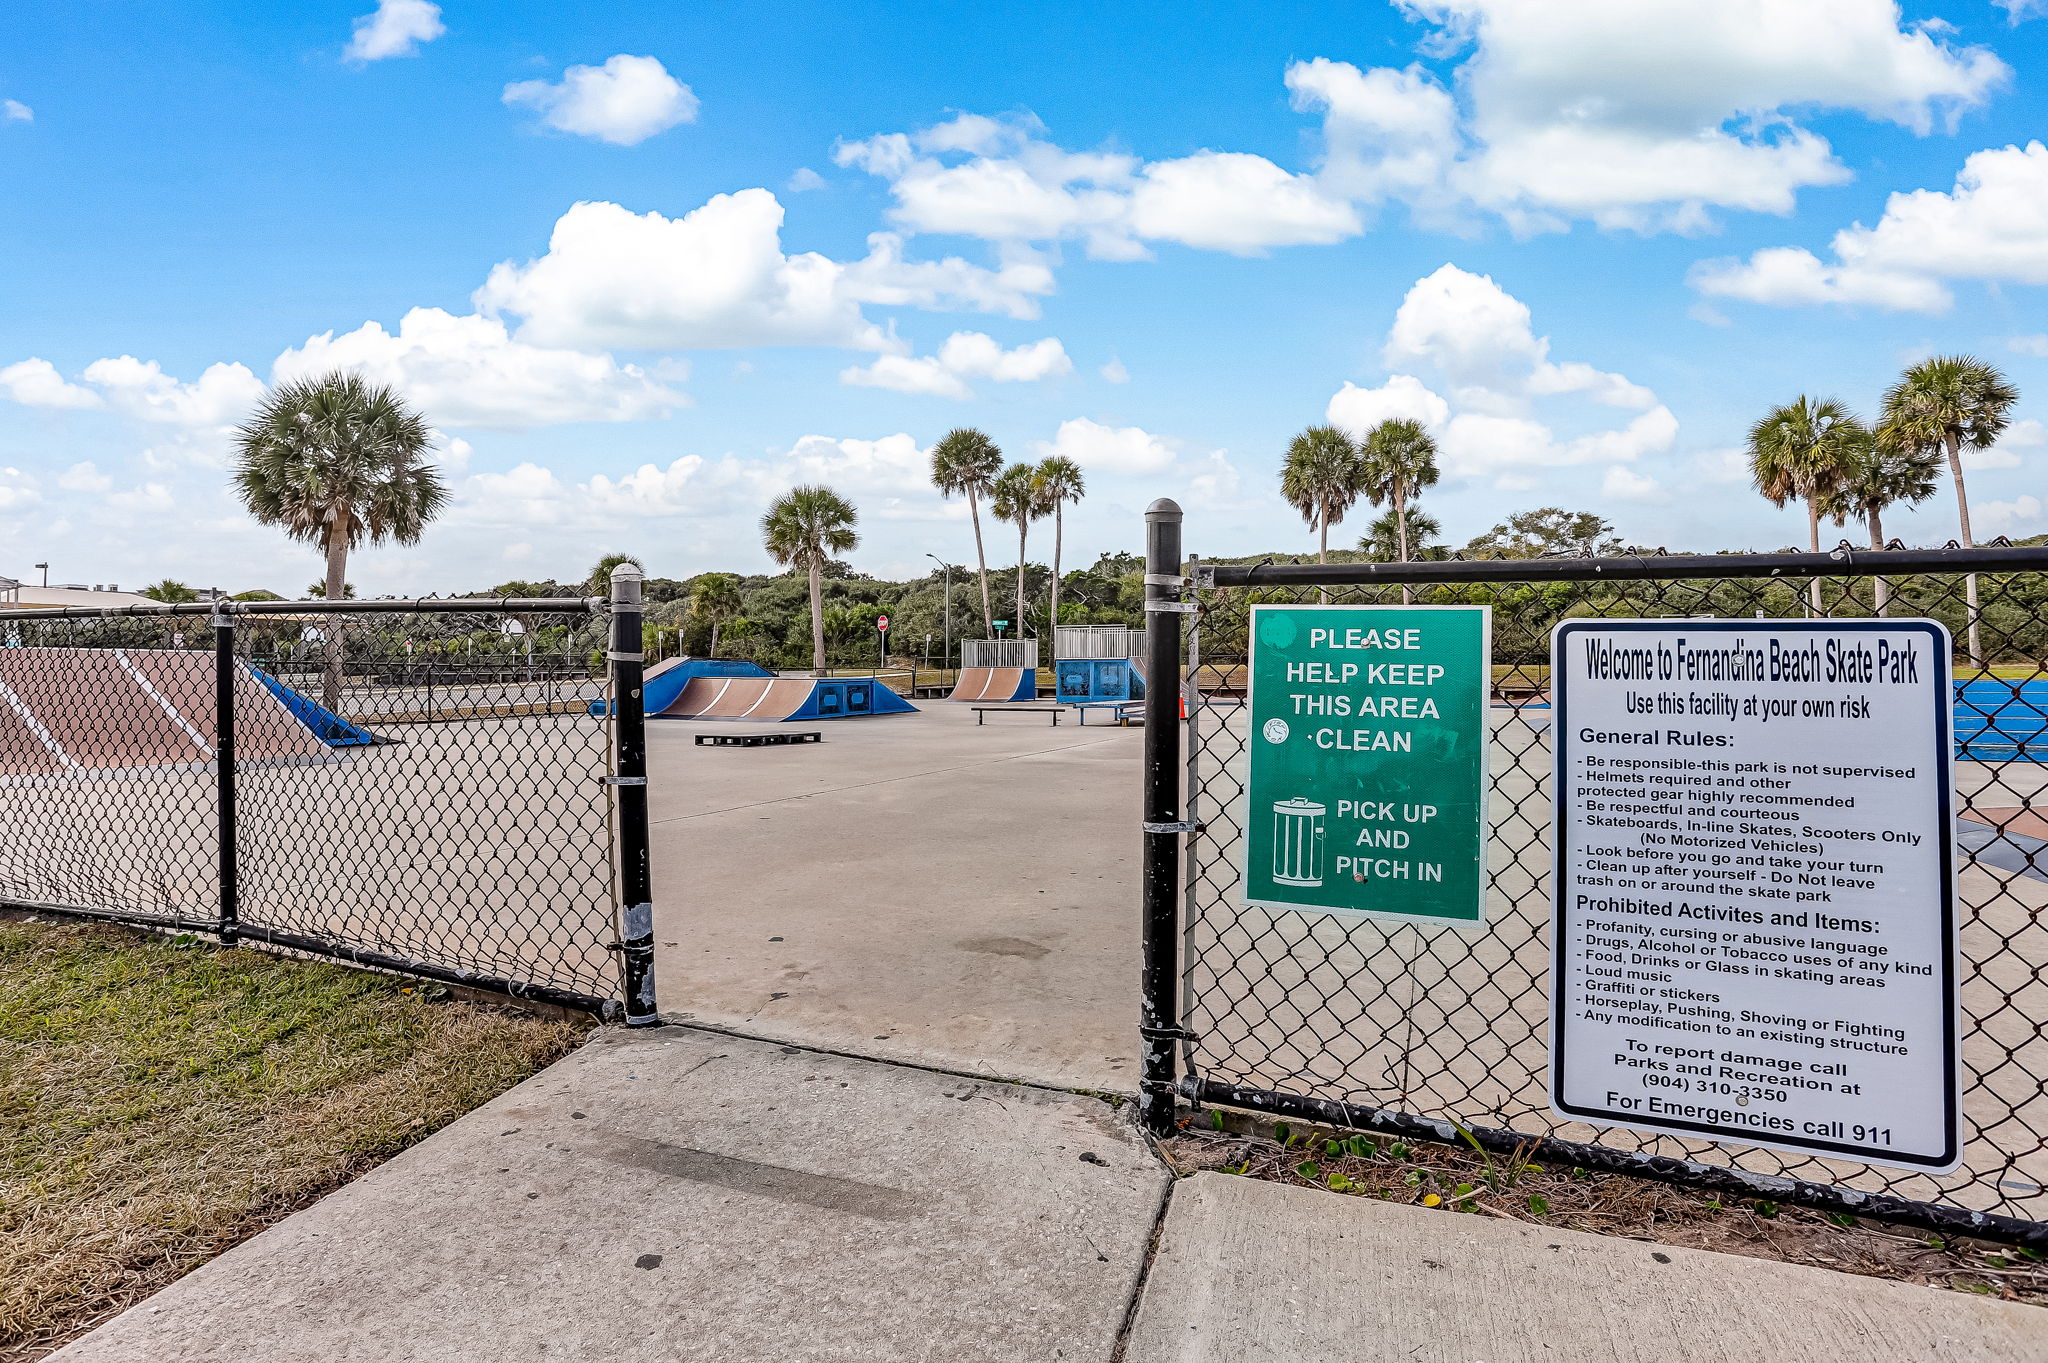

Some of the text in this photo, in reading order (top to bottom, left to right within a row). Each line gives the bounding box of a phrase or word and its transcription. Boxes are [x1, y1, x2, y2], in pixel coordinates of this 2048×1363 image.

[1310, 628, 1421, 650] PLEASE
[1286, 662, 1445, 686] HELP KEEP
[1585, 638, 1918, 684] Welcome to Fernandina Beach Skate Park
[1289, 694, 1441, 719] THIS AREA
[1626, 691, 1870, 723] Use this facility at your own risk
[1315, 727, 1412, 753] CLEAN
[1579, 728, 1734, 747] General Rules:
[1586, 755, 1605, 767] Be
[1610, 758, 1729, 771] responsible-this
[1735, 761, 1768, 774] park
[1774, 762, 1786, 773] is
[1792, 764, 1818, 775] not
[1822, 766, 1915, 779] supervised
[1586, 770, 1644, 783] Helmets
[1649, 774, 1711, 787] required
[1716, 776, 1744, 787] and
[1750, 777, 1791, 789] other
[1337, 799, 1438, 823] PICK UP
[1577, 786, 1854, 808] protected gear highly recommended
[1586, 799, 1605, 811] Be
[1610, 803, 1682, 815] respectful
[1687, 805, 1715, 817] and
[1720, 808, 1799, 821] courteous
[1356, 828, 1410, 849] AND
[1586, 814, 1682, 832] Skateboards,
[1687, 819, 1734, 833] In-line
[1739, 822, 1796, 838] Skates,
[1802, 826, 1876, 841] Scooters
[1881, 830, 1921, 846] Only
[1640, 832, 1823, 856] (No Motorized Vehicles)
[1336, 856, 1443, 882] PITCH IN
[1586, 844, 1622, 857] Look
[1626, 847, 1673, 860] before
[1678, 852, 1706, 864] you
[1711, 854, 1731, 866] go
[1735, 855, 1764, 866] and
[1768, 856, 1802, 868] take
[1807, 860, 1845, 872] your
[1849, 861, 1883, 873] turn
[1576, 874, 1831, 903] trash on or around the skate park
[1586, 859, 1627, 872] Clean
[1632, 865, 1650, 876] up
[1654, 864, 1689, 876] after
[1692, 868, 1756, 881] yourself
[1771, 871, 1793, 883] Do
[1798, 873, 1826, 886] Not
[1832, 875, 1875, 889] leave
[1577, 894, 1879, 933] Prohibited Activites and Items:
[1586, 919, 1654, 937] Profanity,
[1660, 927, 1717, 943] cursing
[1722, 933, 1739, 942] or
[1743, 932, 1805, 948] abusive
[1811, 937, 1888, 957] language
[1586, 934, 1633, 950] Drugs,
[1637, 938, 1695, 954] Alcohol
[1700, 946, 1717, 955] or
[1720, 945, 1788, 962] Tobacco
[1793, 954, 1831, 966] uses
[1837, 957, 1854, 968] of
[1859, 961, 1889, 974] any
[1895, 961, 1932, 976] kind
[1586, 949, 1626, 965] Food,
[1631, 953, 1679, 968] Drinks
[1684, 960, 1701, 970] or
[1705, 960, 1749, 975] Glass
[1755, 964, 1768, 976] in
[1774, 967, 1833, 985] skating
[1839, 975, 1885, 988] areas
[1585, 964, 1622, 978] Loud
[1627, 970, 1672, 983] music
[1585, 979, 1635, 994] Graffiti
[1639, 987, 1656, 996] or
[1660, 987, 1720, 1003] stickers
[1584, 1009, 1613, 1025] Any
[1617, 1015, 1711, 1033] modification
[1716, 1024, 1731, 1035] to
[1736, 1028, 1754, 1038] an
[1760, 1030, 1824, 1049] existing
[1830, 1038, 1908, 1056] structure
[1585, 994, 1662, 1014] Horseplay,
[1667, 1002, 1735, 1022] Pushing,
[1740, 1010, 1806, 1031] Shoving
[1812, 1020, 1829, 1030] or
[1835, 1020, 1905, 1042] Fighting
[1625, 1038, 1846, 1076] To report damage call
[1614, 1053, 1860, 1095] Parks and Recreation at
[1642, 1073, 1787, 1102] (904) 310-3350
[1607, 1091, 1890, 1145] For Emergencies call 911
